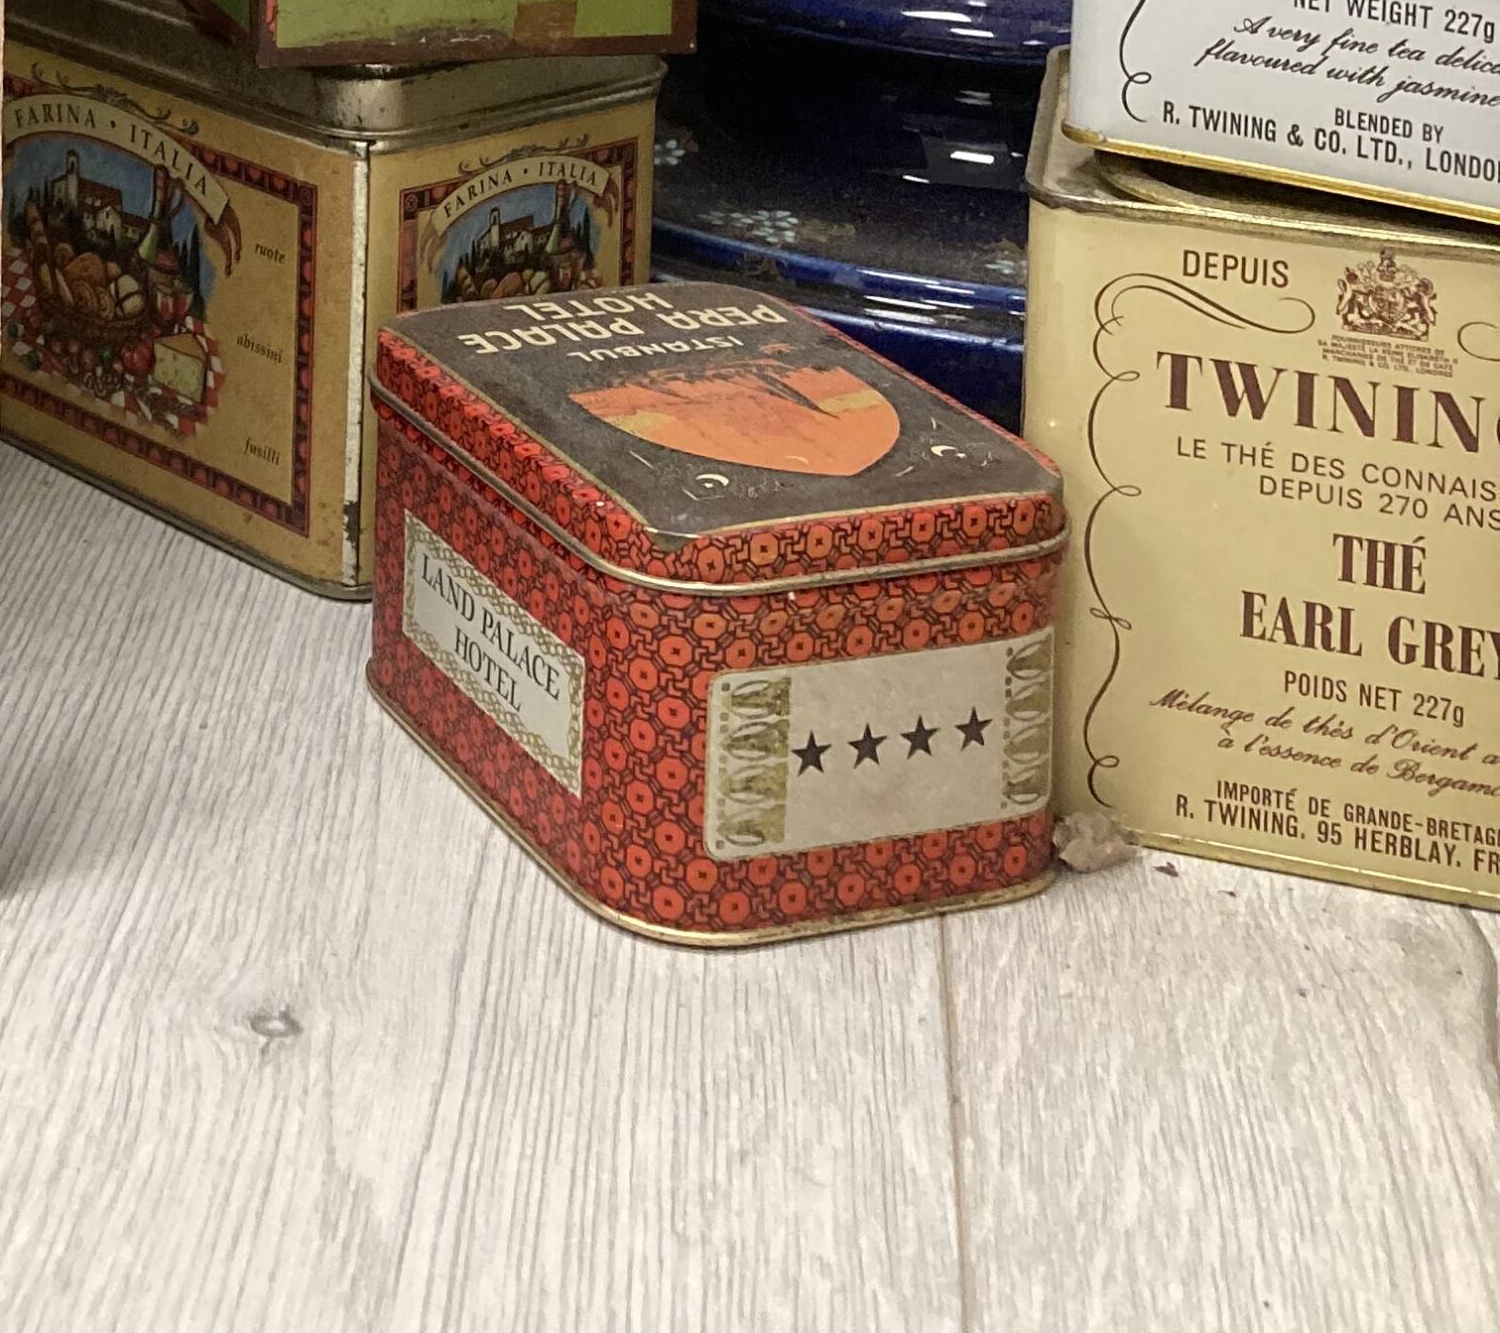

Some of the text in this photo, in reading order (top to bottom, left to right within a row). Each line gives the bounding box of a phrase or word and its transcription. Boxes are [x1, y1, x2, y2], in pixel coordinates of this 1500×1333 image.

[1233, 16, 1273, 34] A
[1267, 27, 1322, 52] very
[1321, 28, 1378, 57] fine
[1389, 38, 1425, 61] tea
[1444, 9, 1495, 44] 227g
[1193, 38, 1500, 108] flavoured with jasmine
[14, 103, 206, 196] FARINA ITALIA
[1163, 100, 1500, 182] R. TWINING & CO. LTD., LONDO
[1335, 108, 1443, 144] BLENDED BY
[443, 161, 597, 218] FARINA ITALIA
[254, 242, 286, 264] ruote
[1182, 249, 1289, 288] DEPUIS
[458, 303, 789, 355] PERA PALACE
[505, 292, 674, 321] HOTEL
[236, 333, 283, 364] abissini
[567, 334, 744, 363] ISTANBUL
[1156, 351, 1500, 453] TWININ
[244, 437, 281, 466] fusilli
[1177, 436, 1496, 502] LE THÉ DES CONNAIS
[1260, 475, 1500, 531] DEPUIS 270 ANS
[1332, 533, 1427, 595] THÉ
[422, 553, 560, 701] LAND PALACE
[1239, 590, 1362, 657] EARL
[454, 626, 521, 712] HOTEL
[1149, 689, 1255, 731] Mélange
[1265, 706, 1295, 729] de
[1303, 713, 1353, 740] thés
[1364, 723, 1478, 761] d'Orient
[1284, 670, 1464, 728] POIDS NET 227g
[1244, 734, 1341, 768] l'essence
[1350, 754, 1379, 775] de
[1176, 794, 1194, 819] R.
[1317, 820, 1342, 846] 95
[1217, 780, 1500, 847] IMPORTÉ DE GRANDE-BRETAG
